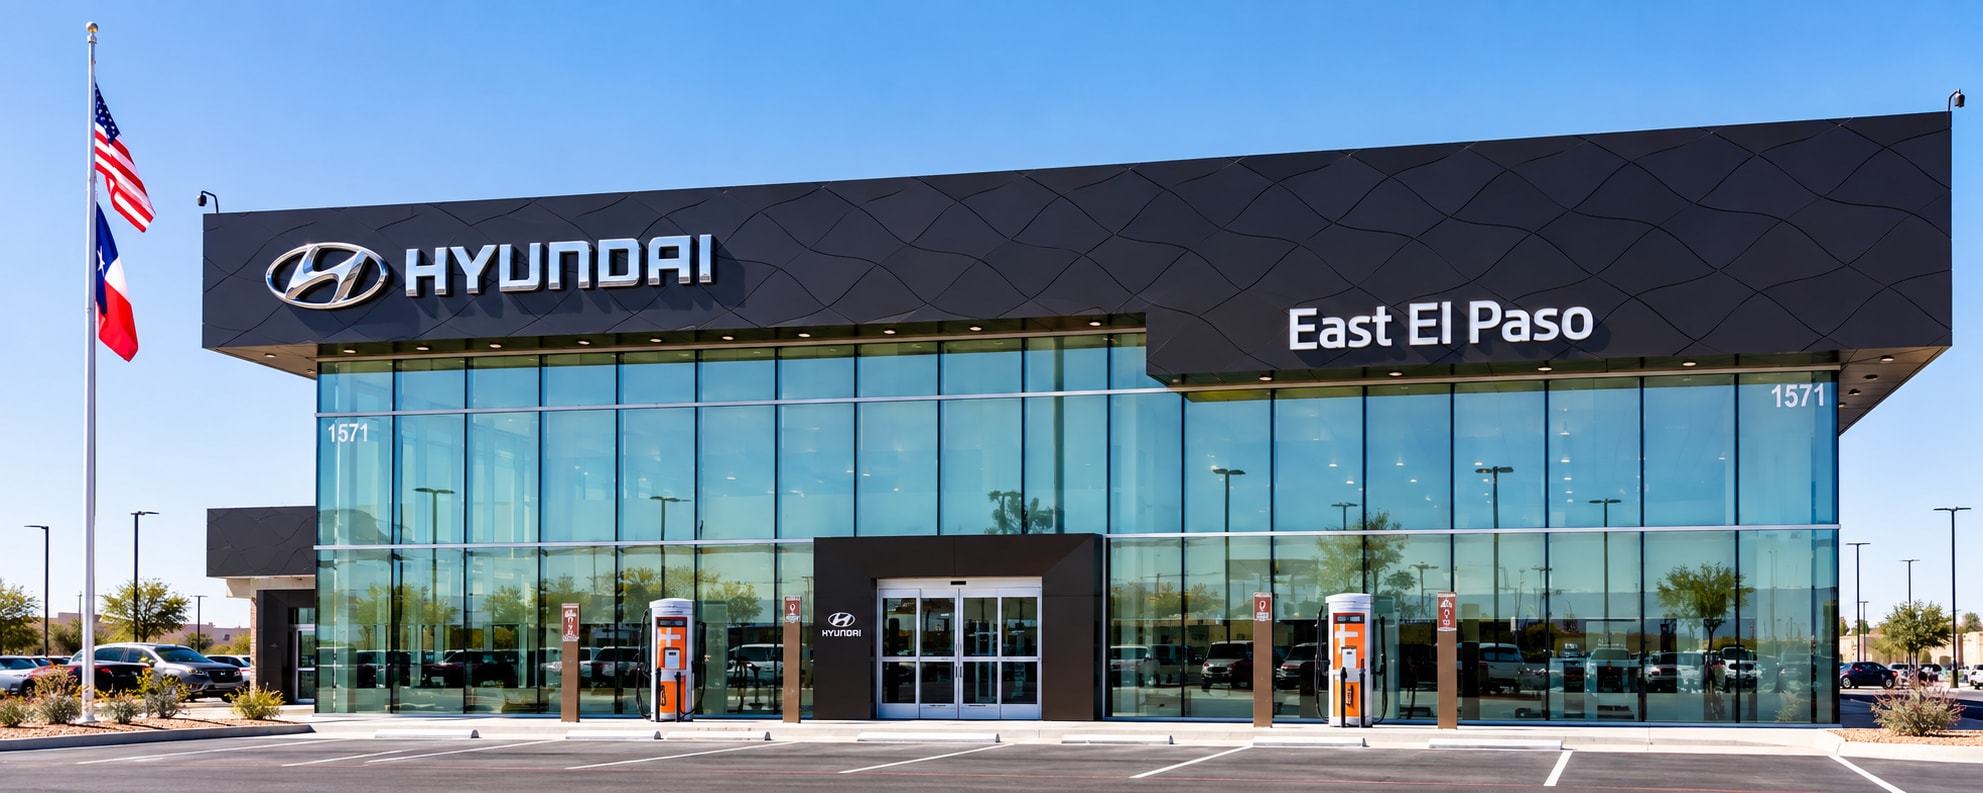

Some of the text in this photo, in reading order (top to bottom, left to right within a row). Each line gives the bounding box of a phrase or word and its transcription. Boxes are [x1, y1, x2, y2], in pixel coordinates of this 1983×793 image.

[404, 233, 713, 297] HYUNDAI
[1289, 300, 1594, 351] East El Paso
[1771, 383, 1825, 408] 1571
[327, 422, 369, 443] 1571
[821, 629, 862, 637] HYUNDAI
